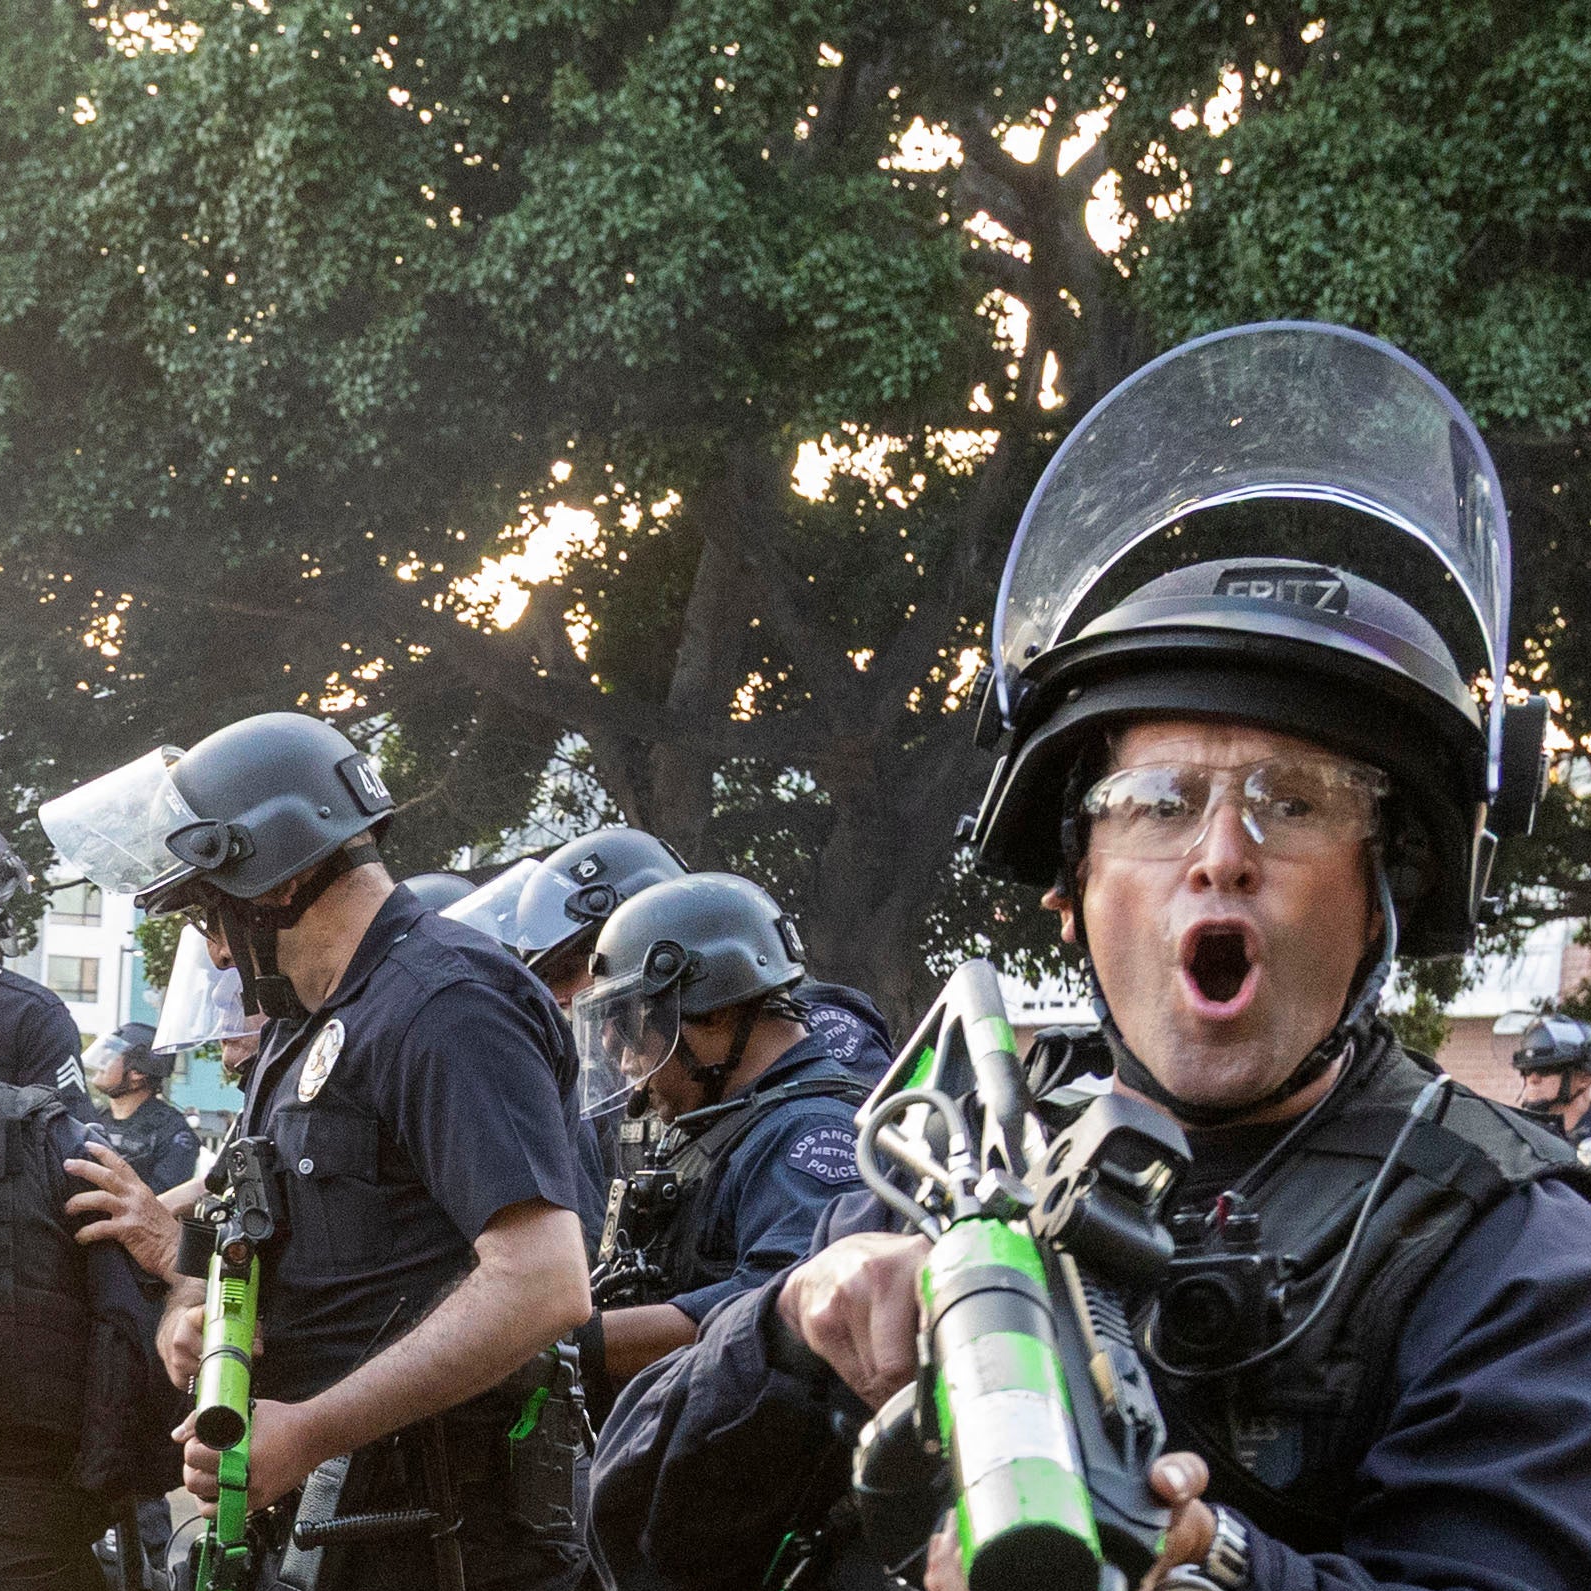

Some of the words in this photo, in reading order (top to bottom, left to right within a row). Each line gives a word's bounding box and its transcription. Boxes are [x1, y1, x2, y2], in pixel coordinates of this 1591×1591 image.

[790, 1135, 817, 1160] LOS
[811, 1146, 858, 1162] METRO
[807, 1159, 859, 1179] POLICE
